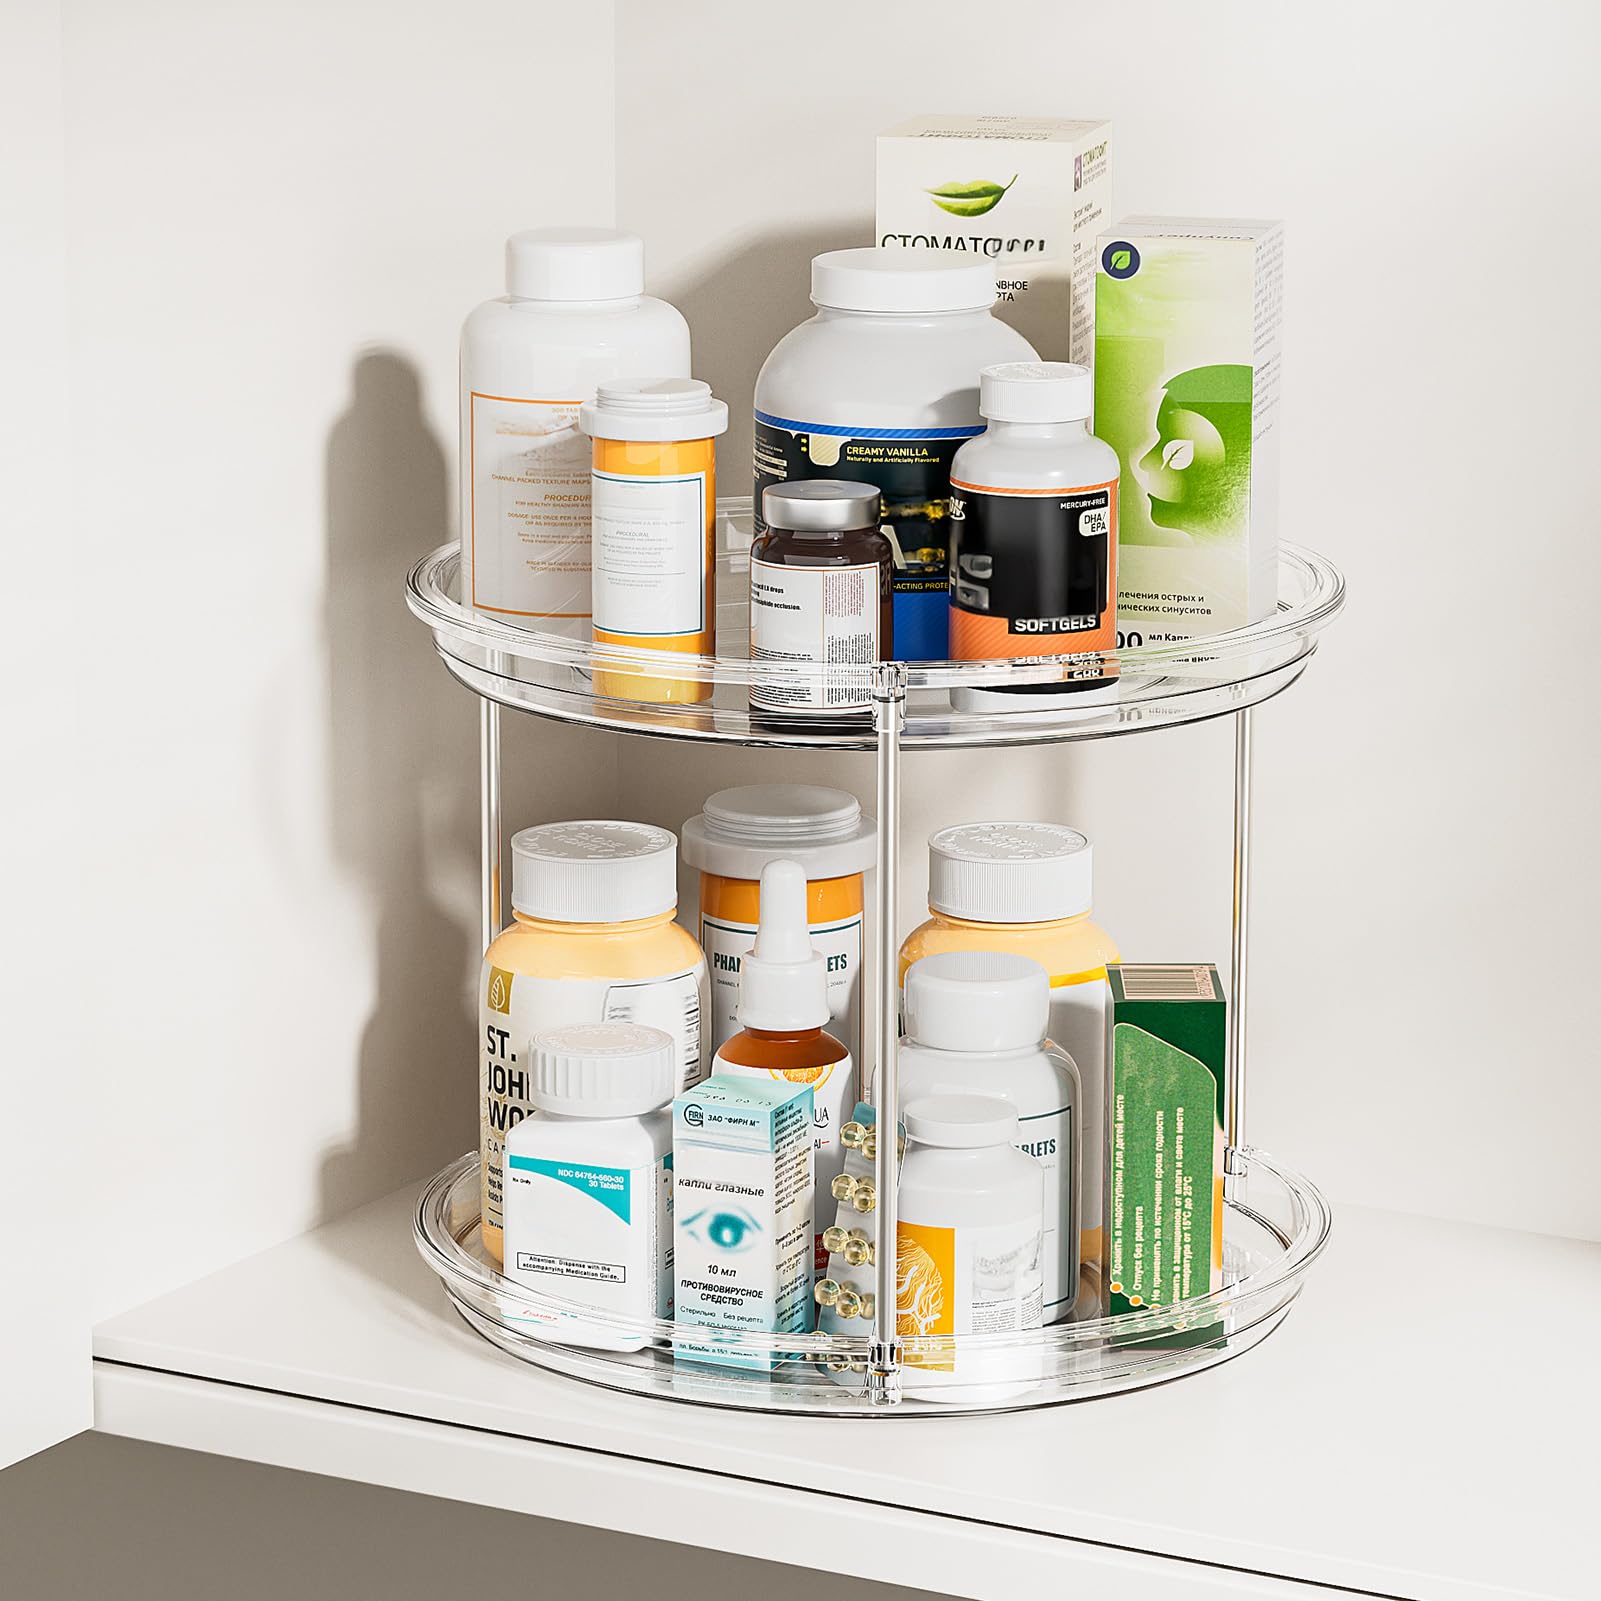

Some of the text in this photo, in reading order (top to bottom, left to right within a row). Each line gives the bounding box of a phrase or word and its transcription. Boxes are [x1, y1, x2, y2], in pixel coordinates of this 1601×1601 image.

[846, 446, 929, 457] CREAMY VANILLA
[1060, 497, 1106, 509] MERCURY-FREE
[1084, 511, 1107, 524] DHA/
[1090, 521, 1107, 532] EPA
[1119, 591, 1159, 599] лечения
[1161, 594, 1195, 603] острых
[1162, 607, 1212, 615] синуситов
[1014, 615, 1097, 632] SOFTGELS
[1148, 633, 1163, 641] мл
[827, 953, 847, 972] ETS
[487, 1024, 516, 1062] ST.
[487, 1096, 536, 1131] WO
[1116, 1094, 1124, 1121] месте
[707, 1114, 723, 1123] ЗАО
[1176, 1107, 1184, 1133] месте
[1115, 1123, 1124, 1150] детей
[1156, 1110, 1164, 1151] годности
[1014, 1138, 1056, 1157] BLETS
[1116, 1151, 1124, 1168] для
[1155, 1153, 1164, 1178] срока
[557, 1169, 573, 1178] NDC
[588, 1180, 625, 1190] 30 Tablets
[678, 1178, 765, 1197] капли глазные
[1115, 1170, 1125, 1229] недоступном
[1175, 1196, 1182, 1206] от
[1184, 1198, 1192, 1210] до
[1154, 1228, 1161, 1239] по
[1184, 1232, 1191, 1242] от
[1133, 1206, 1144, 1290] Отпуск без рецепта
[558, 1259, 586, 1269] Dispense
[1113, 1238, 1122, 1275] Хранить
[1153, 1240, 1162, 1287] применять
[522, 1262, 620, 1280] accompanying Medication Guide.
[707, 1264, 737, 1277] 10 мл
[680, 1279, 764, 1299] ПРОТИВОВИРУСНОЕ
[1151, 1289, 1160, 1301] Не
[700, 1293, 744, 1306] СРЕДСТВО
[680, 1305, 717, 1318] Стерильно
[723, 1312, 735, 1321] Без
